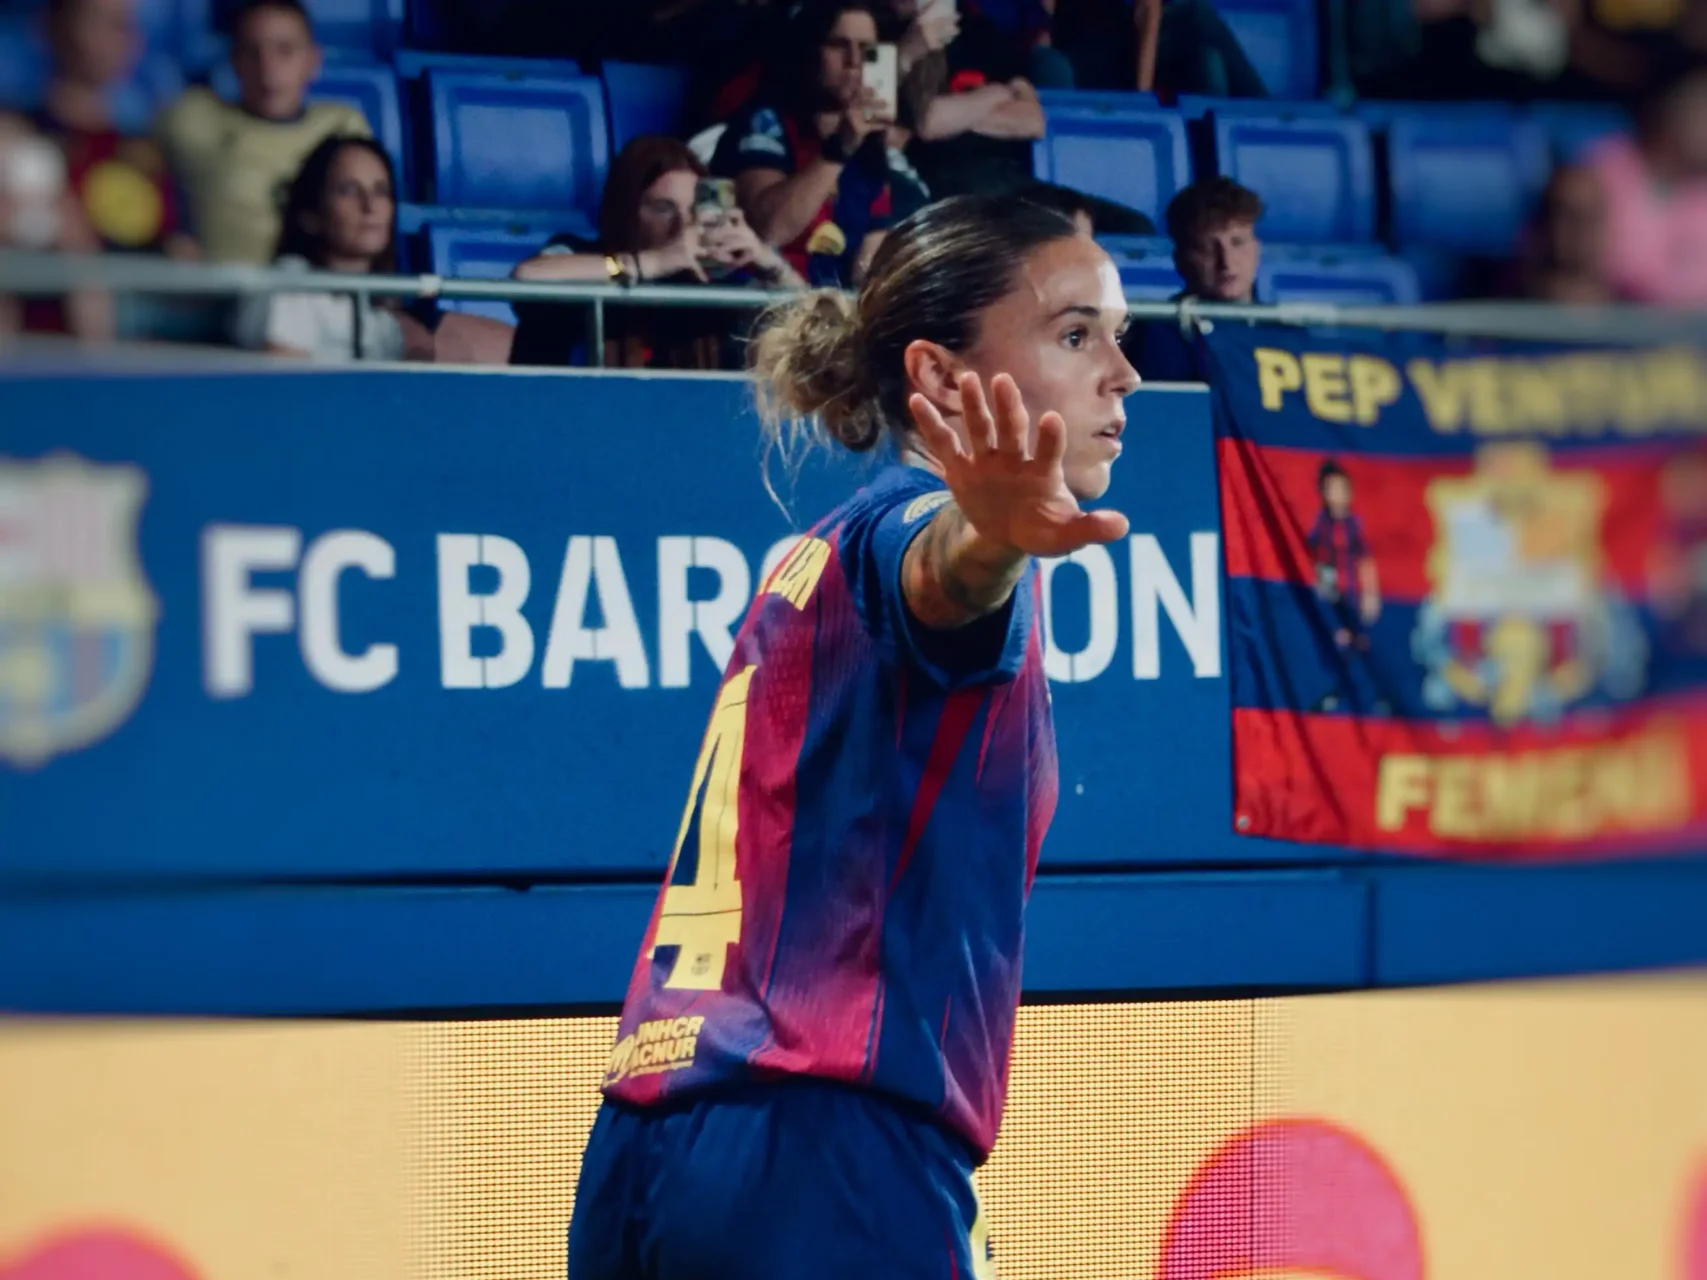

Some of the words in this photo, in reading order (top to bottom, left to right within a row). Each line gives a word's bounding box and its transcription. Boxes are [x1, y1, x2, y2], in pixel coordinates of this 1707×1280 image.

[1254, 347, 1400, 427] PEP
[205, 524, 399, 695] FC
[436, 532, 1222, 690] BARON
[646, 664, 758, 990] 4
